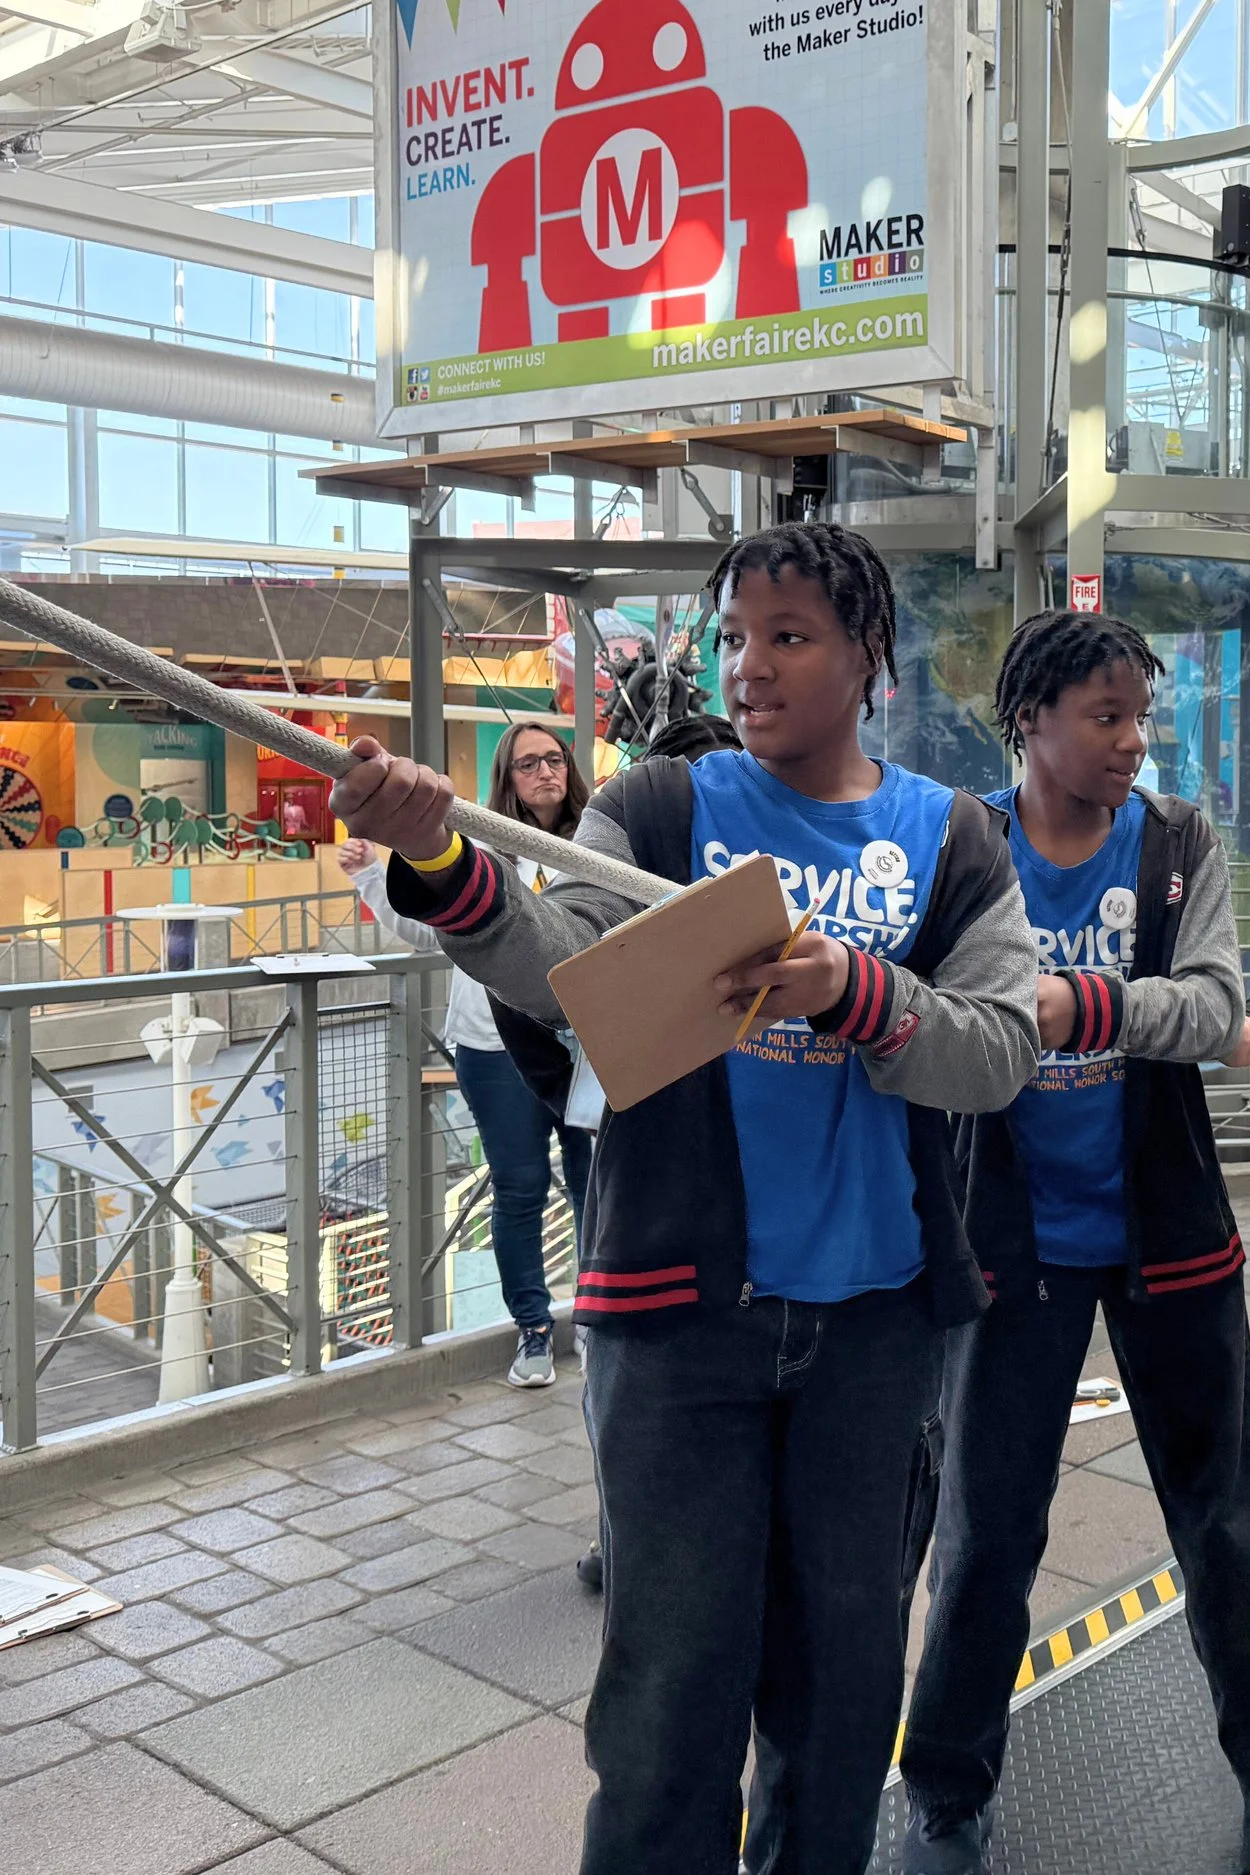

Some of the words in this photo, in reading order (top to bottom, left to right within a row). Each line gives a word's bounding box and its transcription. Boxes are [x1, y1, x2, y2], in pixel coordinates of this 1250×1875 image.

[749, 12, 785, 37] with
[790, 10, 810, 27] us
[815, 0, 862, 20] every
[763, 42, 791, 61] the
[797, 28, 851, 54] Maker
[856, 5, 923, 39] Studio!
[407, 57, 534, 128] INVENT.
[406, 114, 510, 166] CREATE.
[407, 162, 476, 200] LEARN.
[597, 147, 662, 250] M
[820, 214, 924, 261] MAKER
[820, 287, 838, 295] WHERE
[839, 282, 871, 292] CREATIVITY
[873, 277, 898, 287] BECOMES
[900, 275, 923, 283] REALITY
[822, 252, 922, 284] studio
[653, 311, 924, 367] makerfairekc.com
[437, 358, 491, 379] CONNECT
[493, 356, 522, 371] WITH
[526, 352, 545, 367] US!
[437, 378, 502, 396] #makerfairekc
[1075, 586, 1096, 598] FIRE
[704, 841, 917, 926] SRVICE
[1031, 921, 1137, 966] RVICE
[737, 1041, 796, 1064] NATIONAL
[804, 1050, 846, 1065] HONOR
[815, 1035, 848, 1049] SOUT
[1074, 1074, 1107, 1088] HONOR
[1082, 1061, 1114, 1076] SOUTH
